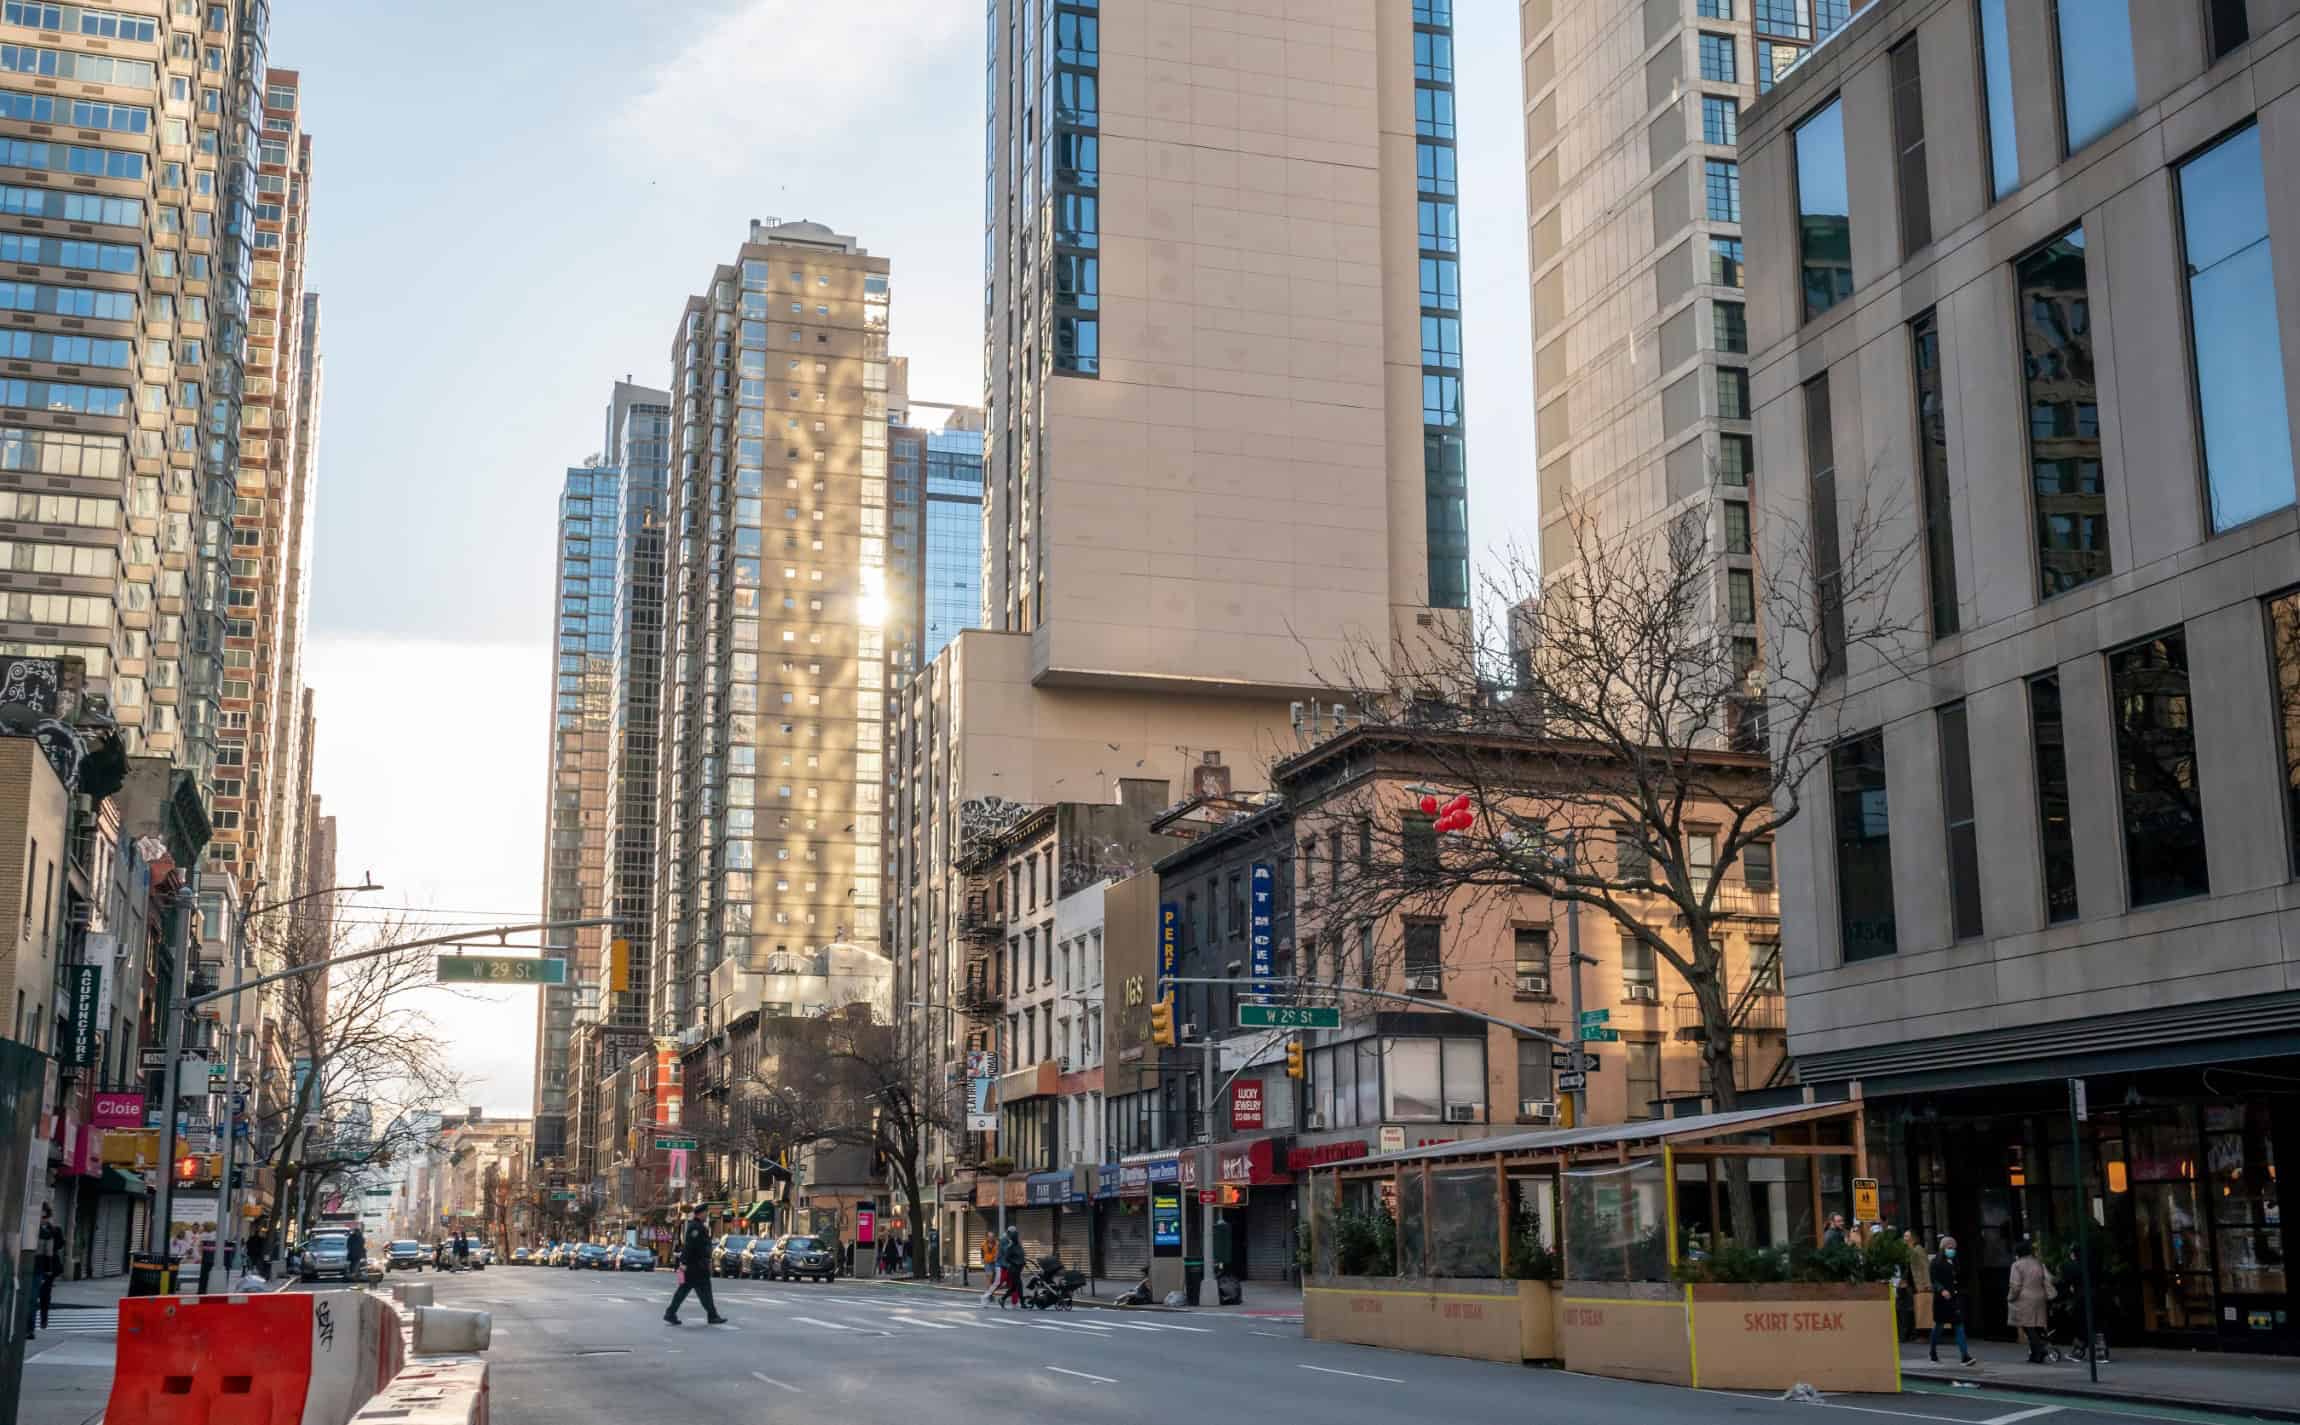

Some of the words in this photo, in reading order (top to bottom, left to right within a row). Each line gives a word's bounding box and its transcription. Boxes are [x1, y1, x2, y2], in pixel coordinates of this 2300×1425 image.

[473, 960, 484, 976] W
[490, 962, 509, 977] 29
[515, 963, 531, 977] St
[76, 968, 92, 1062] ACUPUNCTURE
[1266, 1010, 1276, 1023] W
[1281, 1009, 1296, 1024] 29
[1301, 1010, 1313, 1024] St
[1238, 1088, 1258, 1099] LUCKY
[1234, 1100, 1262, 1111] JEWELRY
[1744, 1312, 1787, 1332] SKIRT
[1792, 1312, 1845, 1332] STEAK
